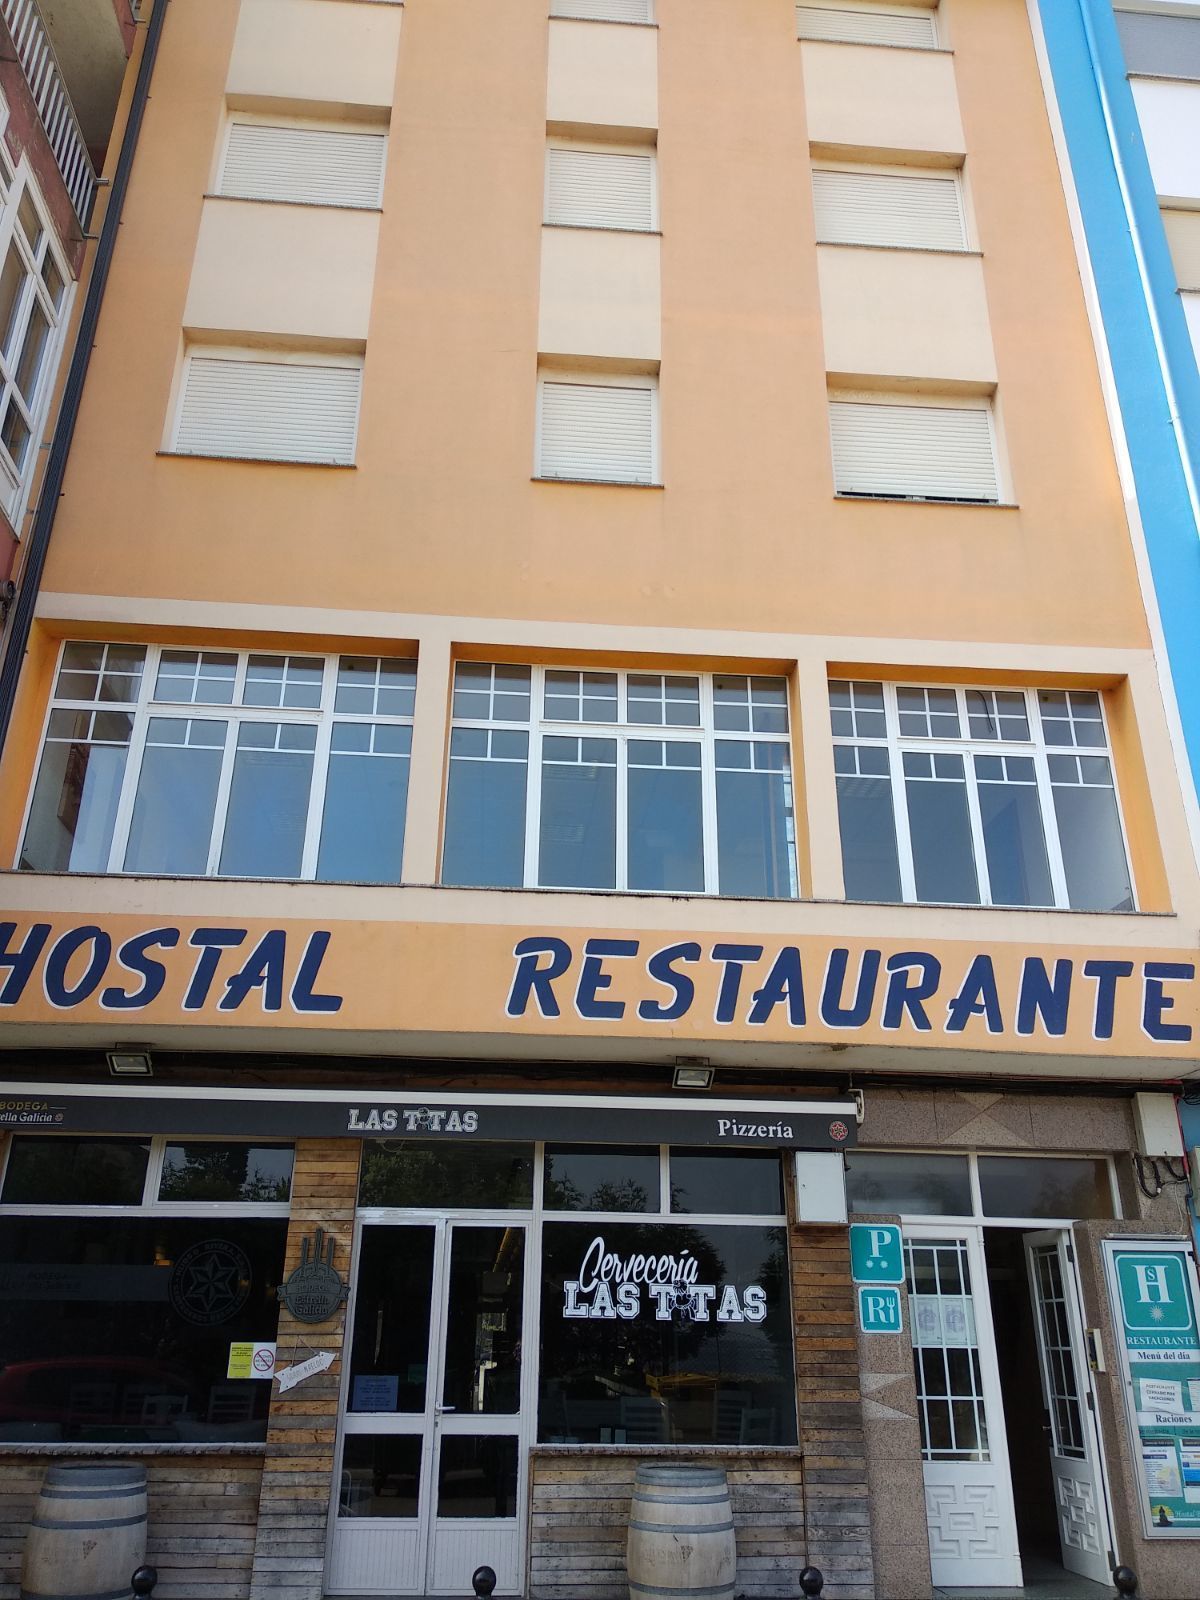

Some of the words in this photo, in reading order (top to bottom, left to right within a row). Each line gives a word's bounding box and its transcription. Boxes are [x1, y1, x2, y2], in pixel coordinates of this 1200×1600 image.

[0, 922, 343, 1014] HOSTAL
[505, 936, 1195, 1043] RESTAURANTE
[19, 1112, 53, 1122] Galicia
[347, 1108, 398, 1131] LAS
[402, 1107, 479, 1133] TTAS
[717, 1119, 794, 1139] Pizzería
[868, 1229, 892, 1258] P
[579, 1236, 699, 1293] Cervecería
[1131, 1264, 1174, 1303] H
[562, 1280, 641, 1320] LAS
[648, 1278, 768, 1323] TTAS
[865, 1296, 889, 1323] R
[1127, 1336, 1197, 1346] RESTAURANTE
[1137, 1351, 1162, 1360] Menú
[1163, 1351, 1176, 1360] del
[1177, 1351, 1191, 1360] día
[1155, 1414, 1193, 1424] Raciones
